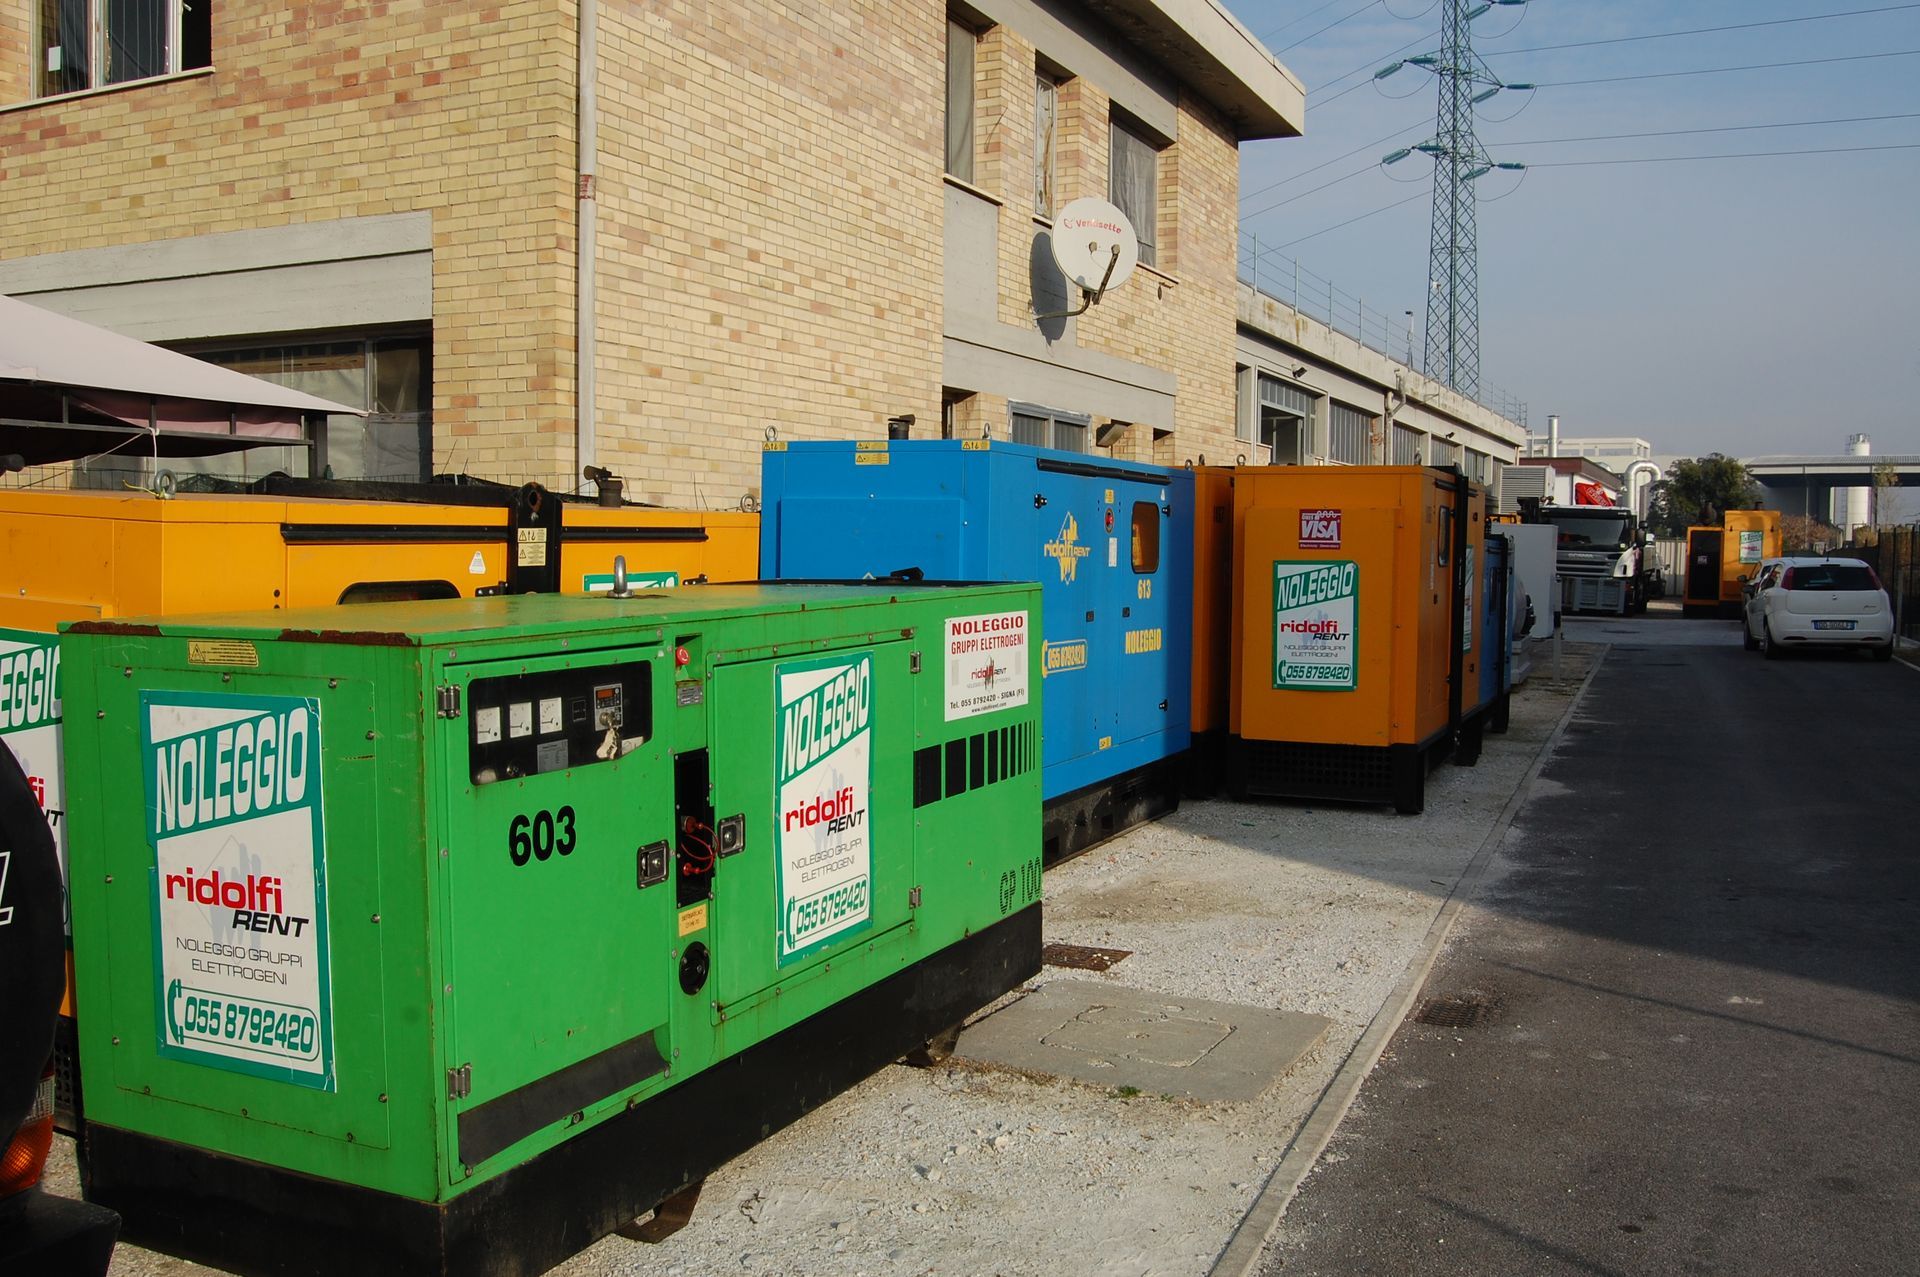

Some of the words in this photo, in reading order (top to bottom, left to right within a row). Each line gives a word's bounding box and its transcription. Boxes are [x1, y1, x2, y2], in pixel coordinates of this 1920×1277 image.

[1301, 521, 1339, 543] VISA
[1137, 579, 1152, 599] 613
[1277, 563, 1354, 610] NOLEGGIO
[952, 615, 1024, 636] NOLEGGIO
[1280, 620, 1338, 633] ridolfi
[1312, 633, 1350, 641] RENT
[951, 639, 979, 654] GRUPPI
[981, 633, 1024, 651] ELETTROGENI
[1125, 628, 1162, 655] NOLEGGIO
[1286, 665, 1304, 679] 055
[1305, 665, 1350, 680] 8792420
[950, 701, 959, 709] Tel.
[960, 698, 972, 707] 055
[973, 694, 996, 705] 8792420
[1001, 689, 1016, 700] SIGNA
[781, 657, 870, 782] NOLEGGIO
[156, 707, 309, 834] NOLEGGIO
[786, 786, 853, 832] ridolfi
[827, 809, 865, 836] RENT
[508, 805, 577, 867] 603
[791, 847, 835, 871] NOLEGGIO
[835, 838, 862, 856] GRUPPI
[801, 856, 855, 883] ELETTROGENI
[166, 867, 282, 914] ridolfi
[1000, 869, 1016, 915] GP
[795, 900, 818, 935] 055
[819, 879, 867, 926] 8792420
[232, 909, 309, 938] RENT
[176, 936, 246, 959] NOLEGGIO
[248, 948, 303, 968] GRUPPI
[191, 958, 288, 986] ELETTROGENI
[184, 996, 222, 1036] 055
[224, 1003, 315, 1054] 8792420
